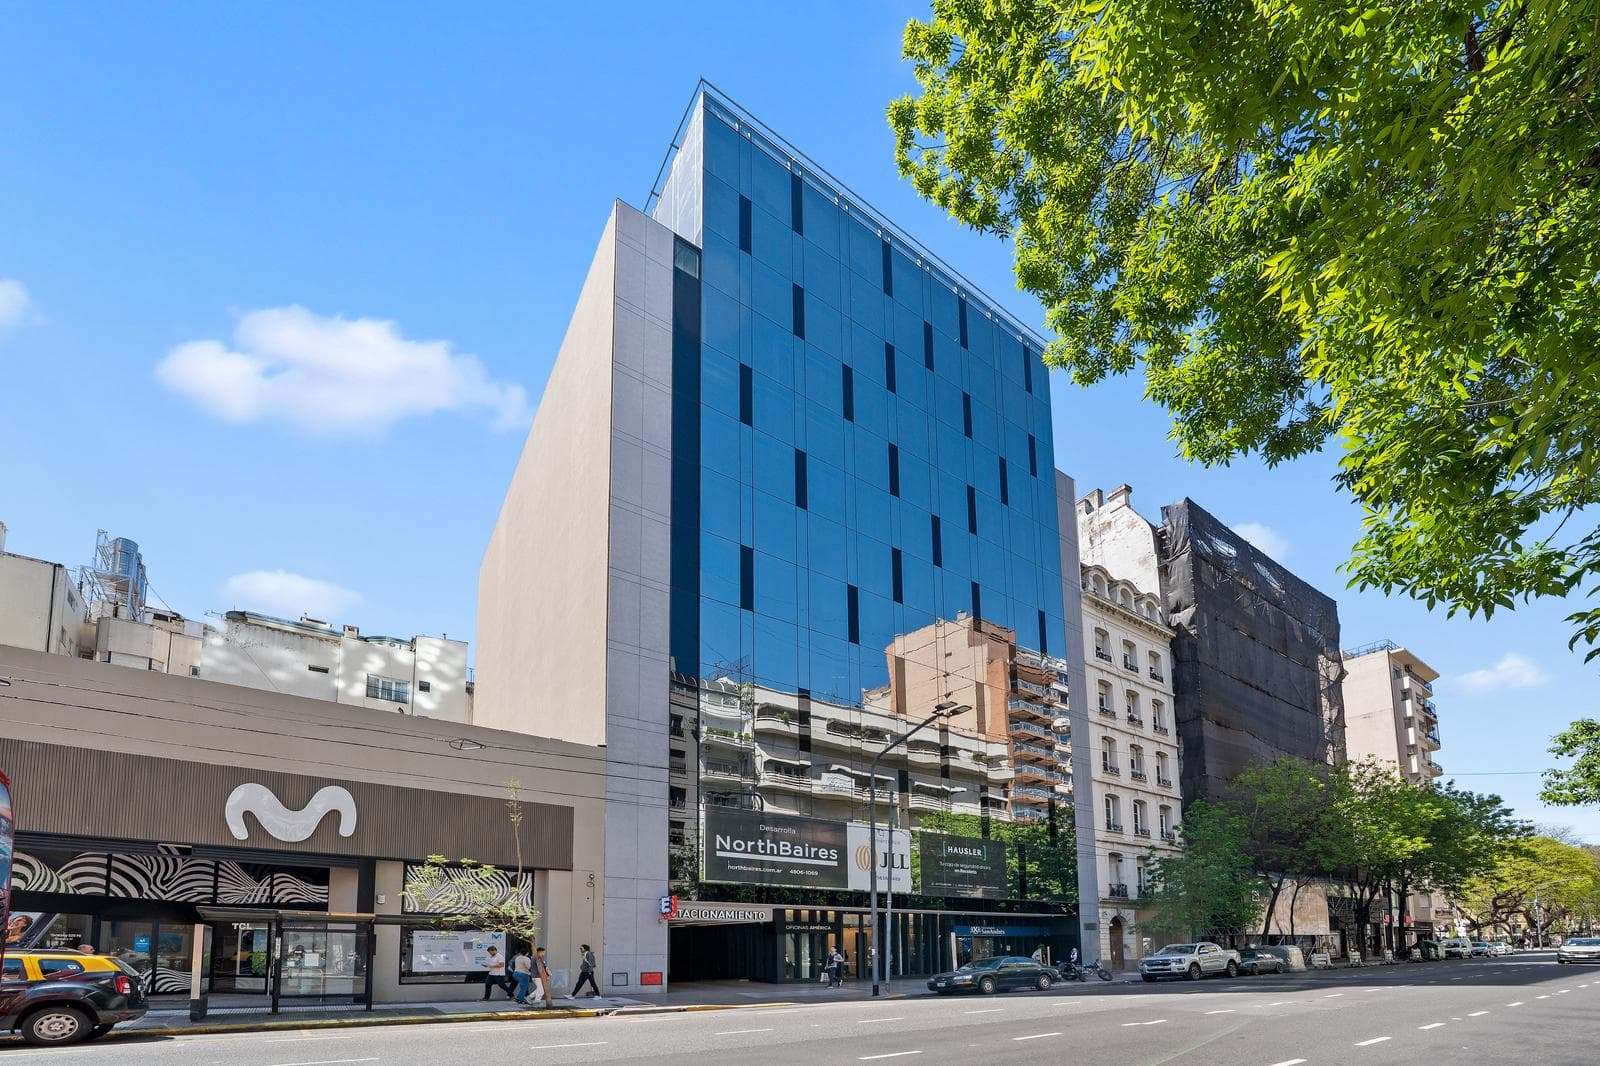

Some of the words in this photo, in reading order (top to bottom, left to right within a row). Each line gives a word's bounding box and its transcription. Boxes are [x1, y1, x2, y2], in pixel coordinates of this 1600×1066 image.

[759, 824, 796, 835] Desarrolla
[715, 834, 838, 860] NorthBaires
[947, 845, 982, 857] HAUSLER
[880, 852, 909, 870] JLL
[231, 922, 252, 930] TCL
